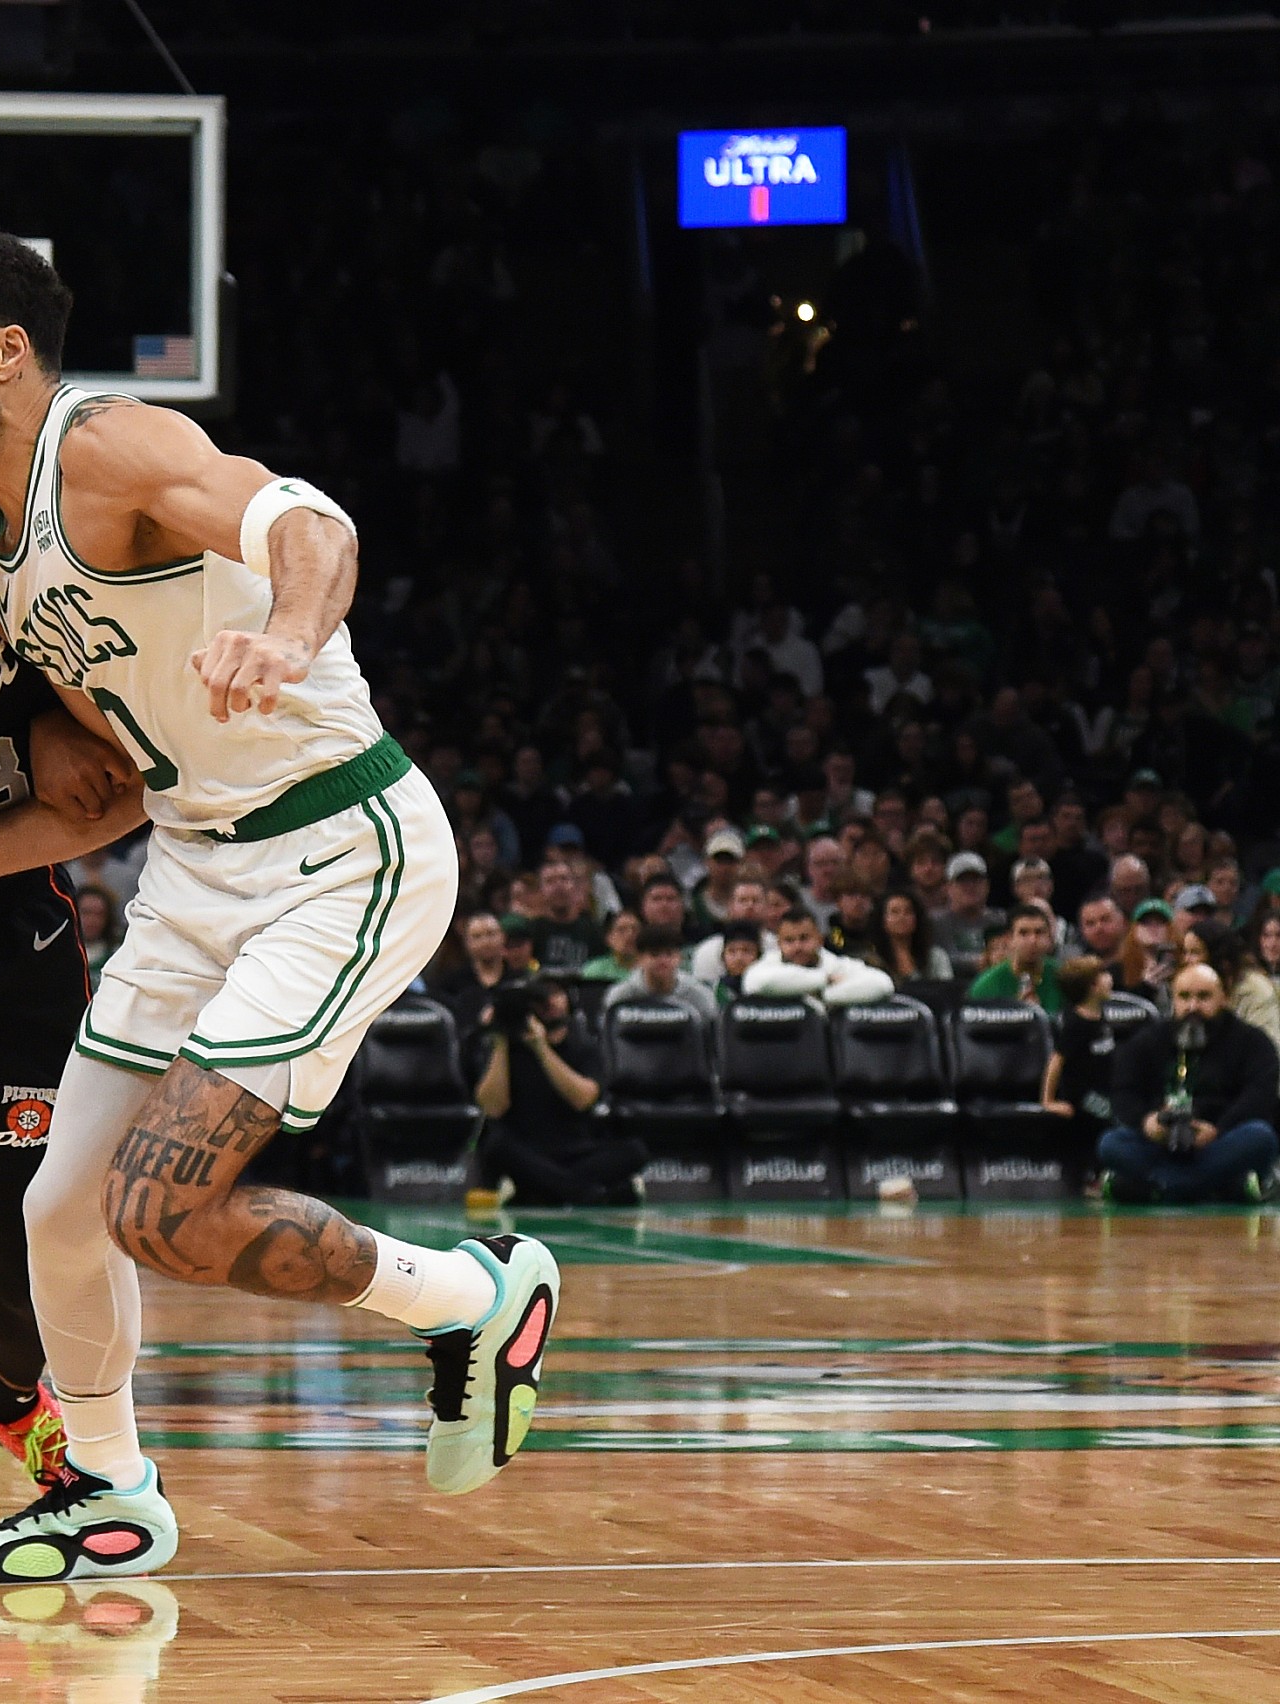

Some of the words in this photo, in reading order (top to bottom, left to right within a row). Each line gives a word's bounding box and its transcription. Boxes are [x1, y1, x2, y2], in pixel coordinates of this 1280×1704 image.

[704, 154, 818, 187] ULTRA
[33, 510, 50, 538] VISTA
[37, 531, 55, 554] PRINT
[1, 1085, 58, 1106] PISTON
[111, 1127, 218, 1187] ATEFUL
